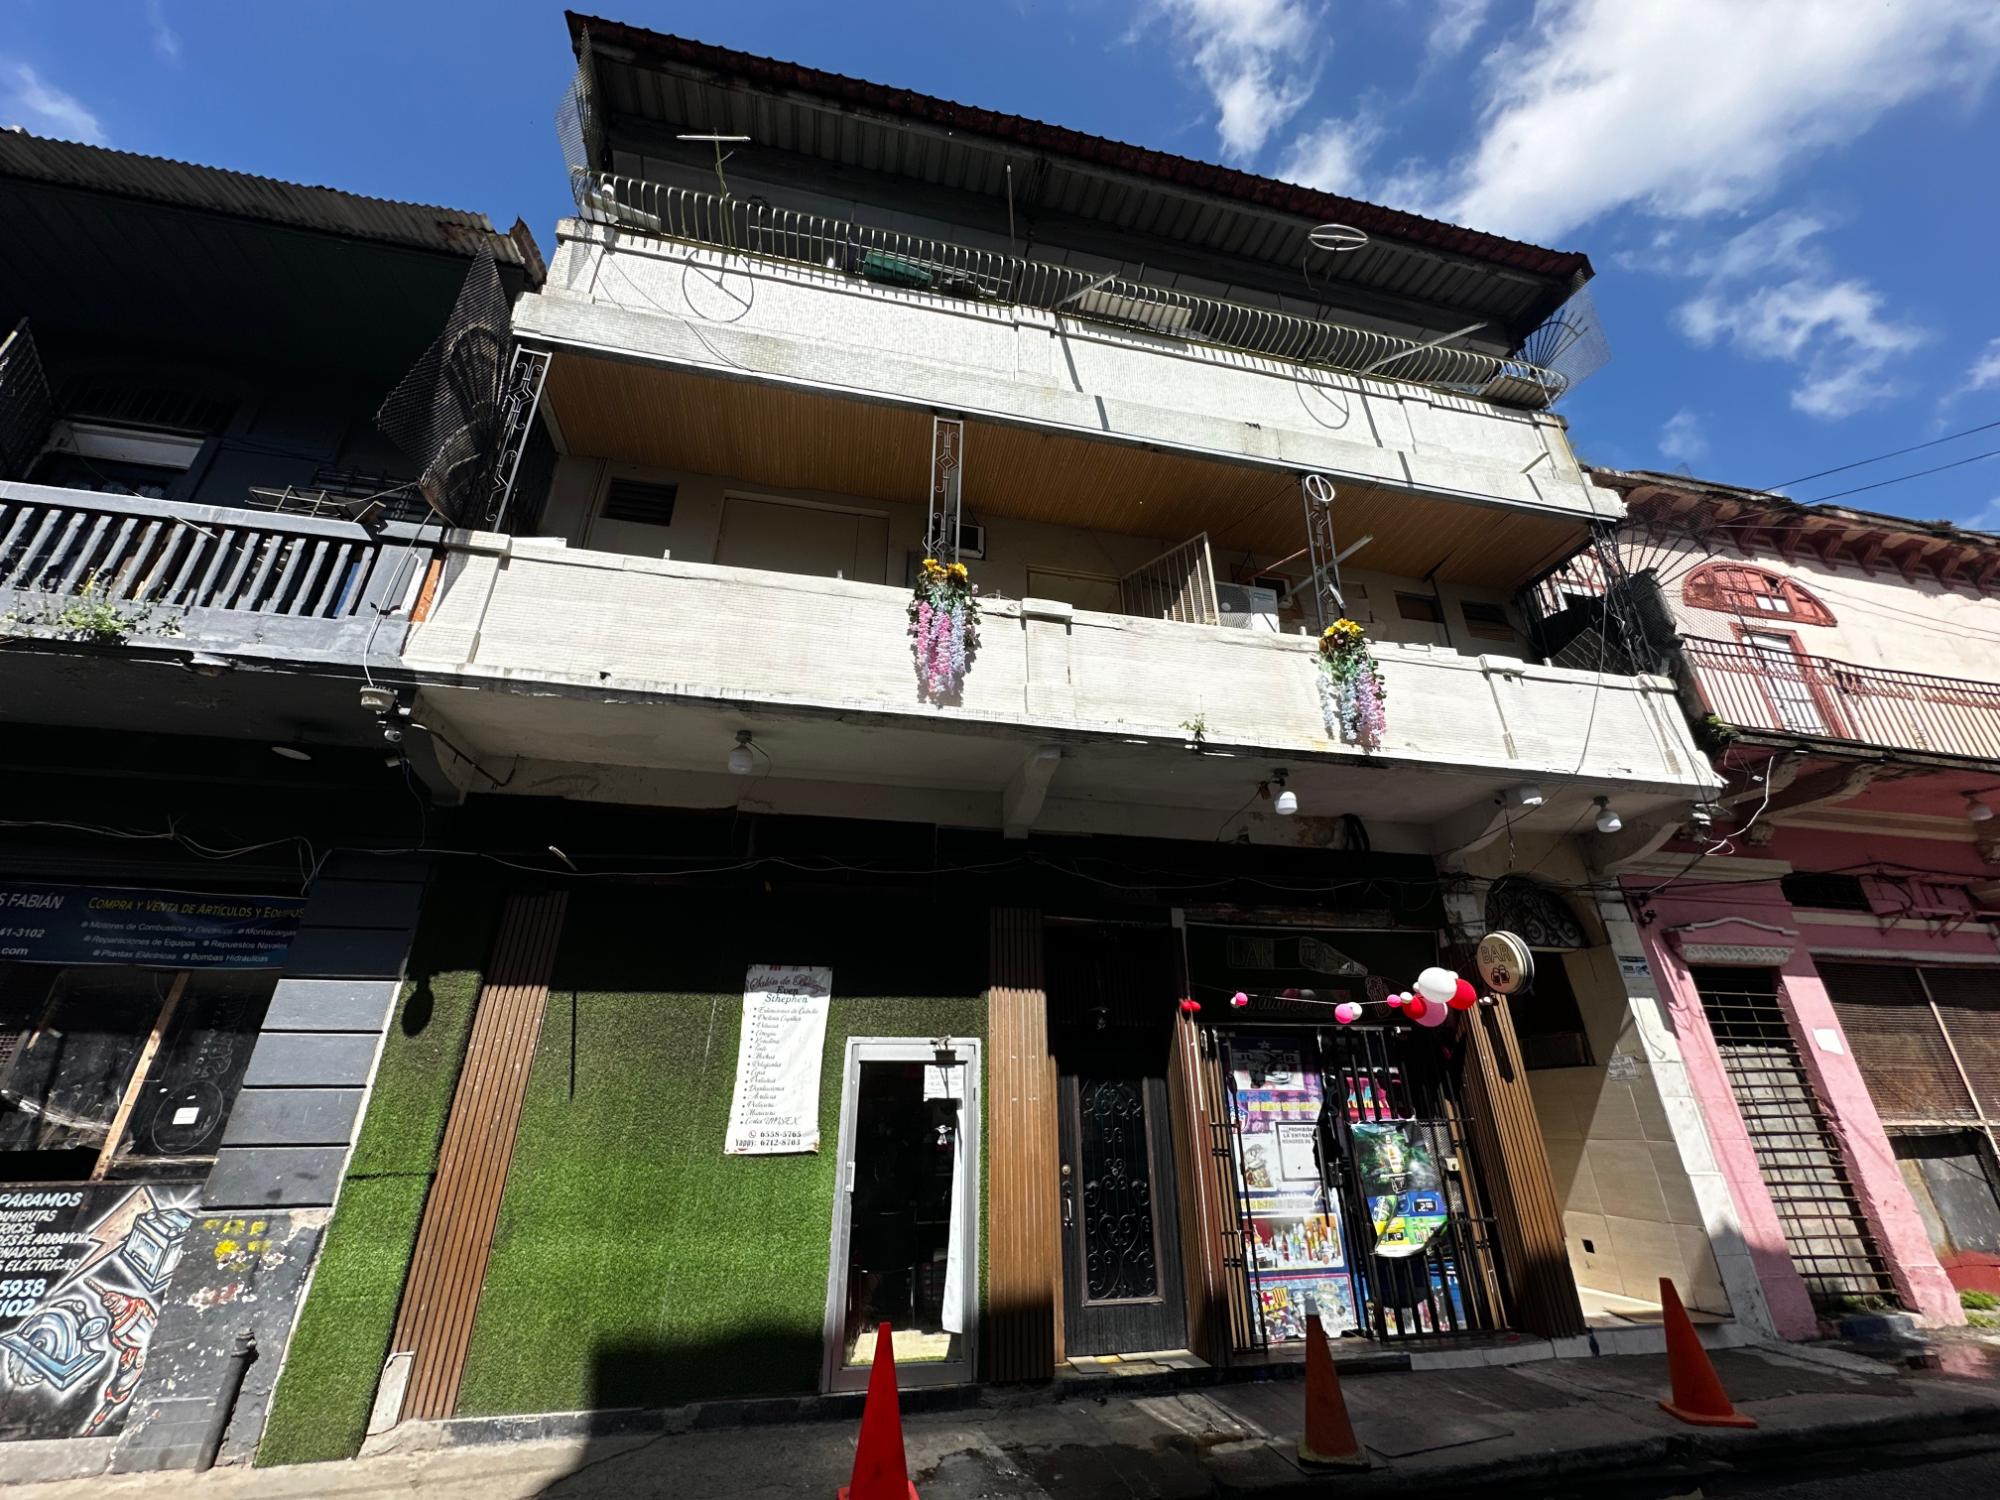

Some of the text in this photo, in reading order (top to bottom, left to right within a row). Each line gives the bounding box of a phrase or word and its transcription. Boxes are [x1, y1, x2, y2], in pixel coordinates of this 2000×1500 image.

[7, 892, 65, 909] FABIÁN
[88, 897, 133, 910] COMPRA
[136, 900, 144, 910] Y
[145, 900, 179, 912] VENTA
[180, 903, 197, 914] DE
[198, 902, 252, 917] ARTÍCULOS
[255, 907, 263, 918] Y
[164, 939, 196, 949] Equipos
[211, 940, 255, 950] Repuestos
[190, 952, 223, 962] Bombas
[1481, 943, 1512, 964] BAR
[780, 976, 790, 985] de
